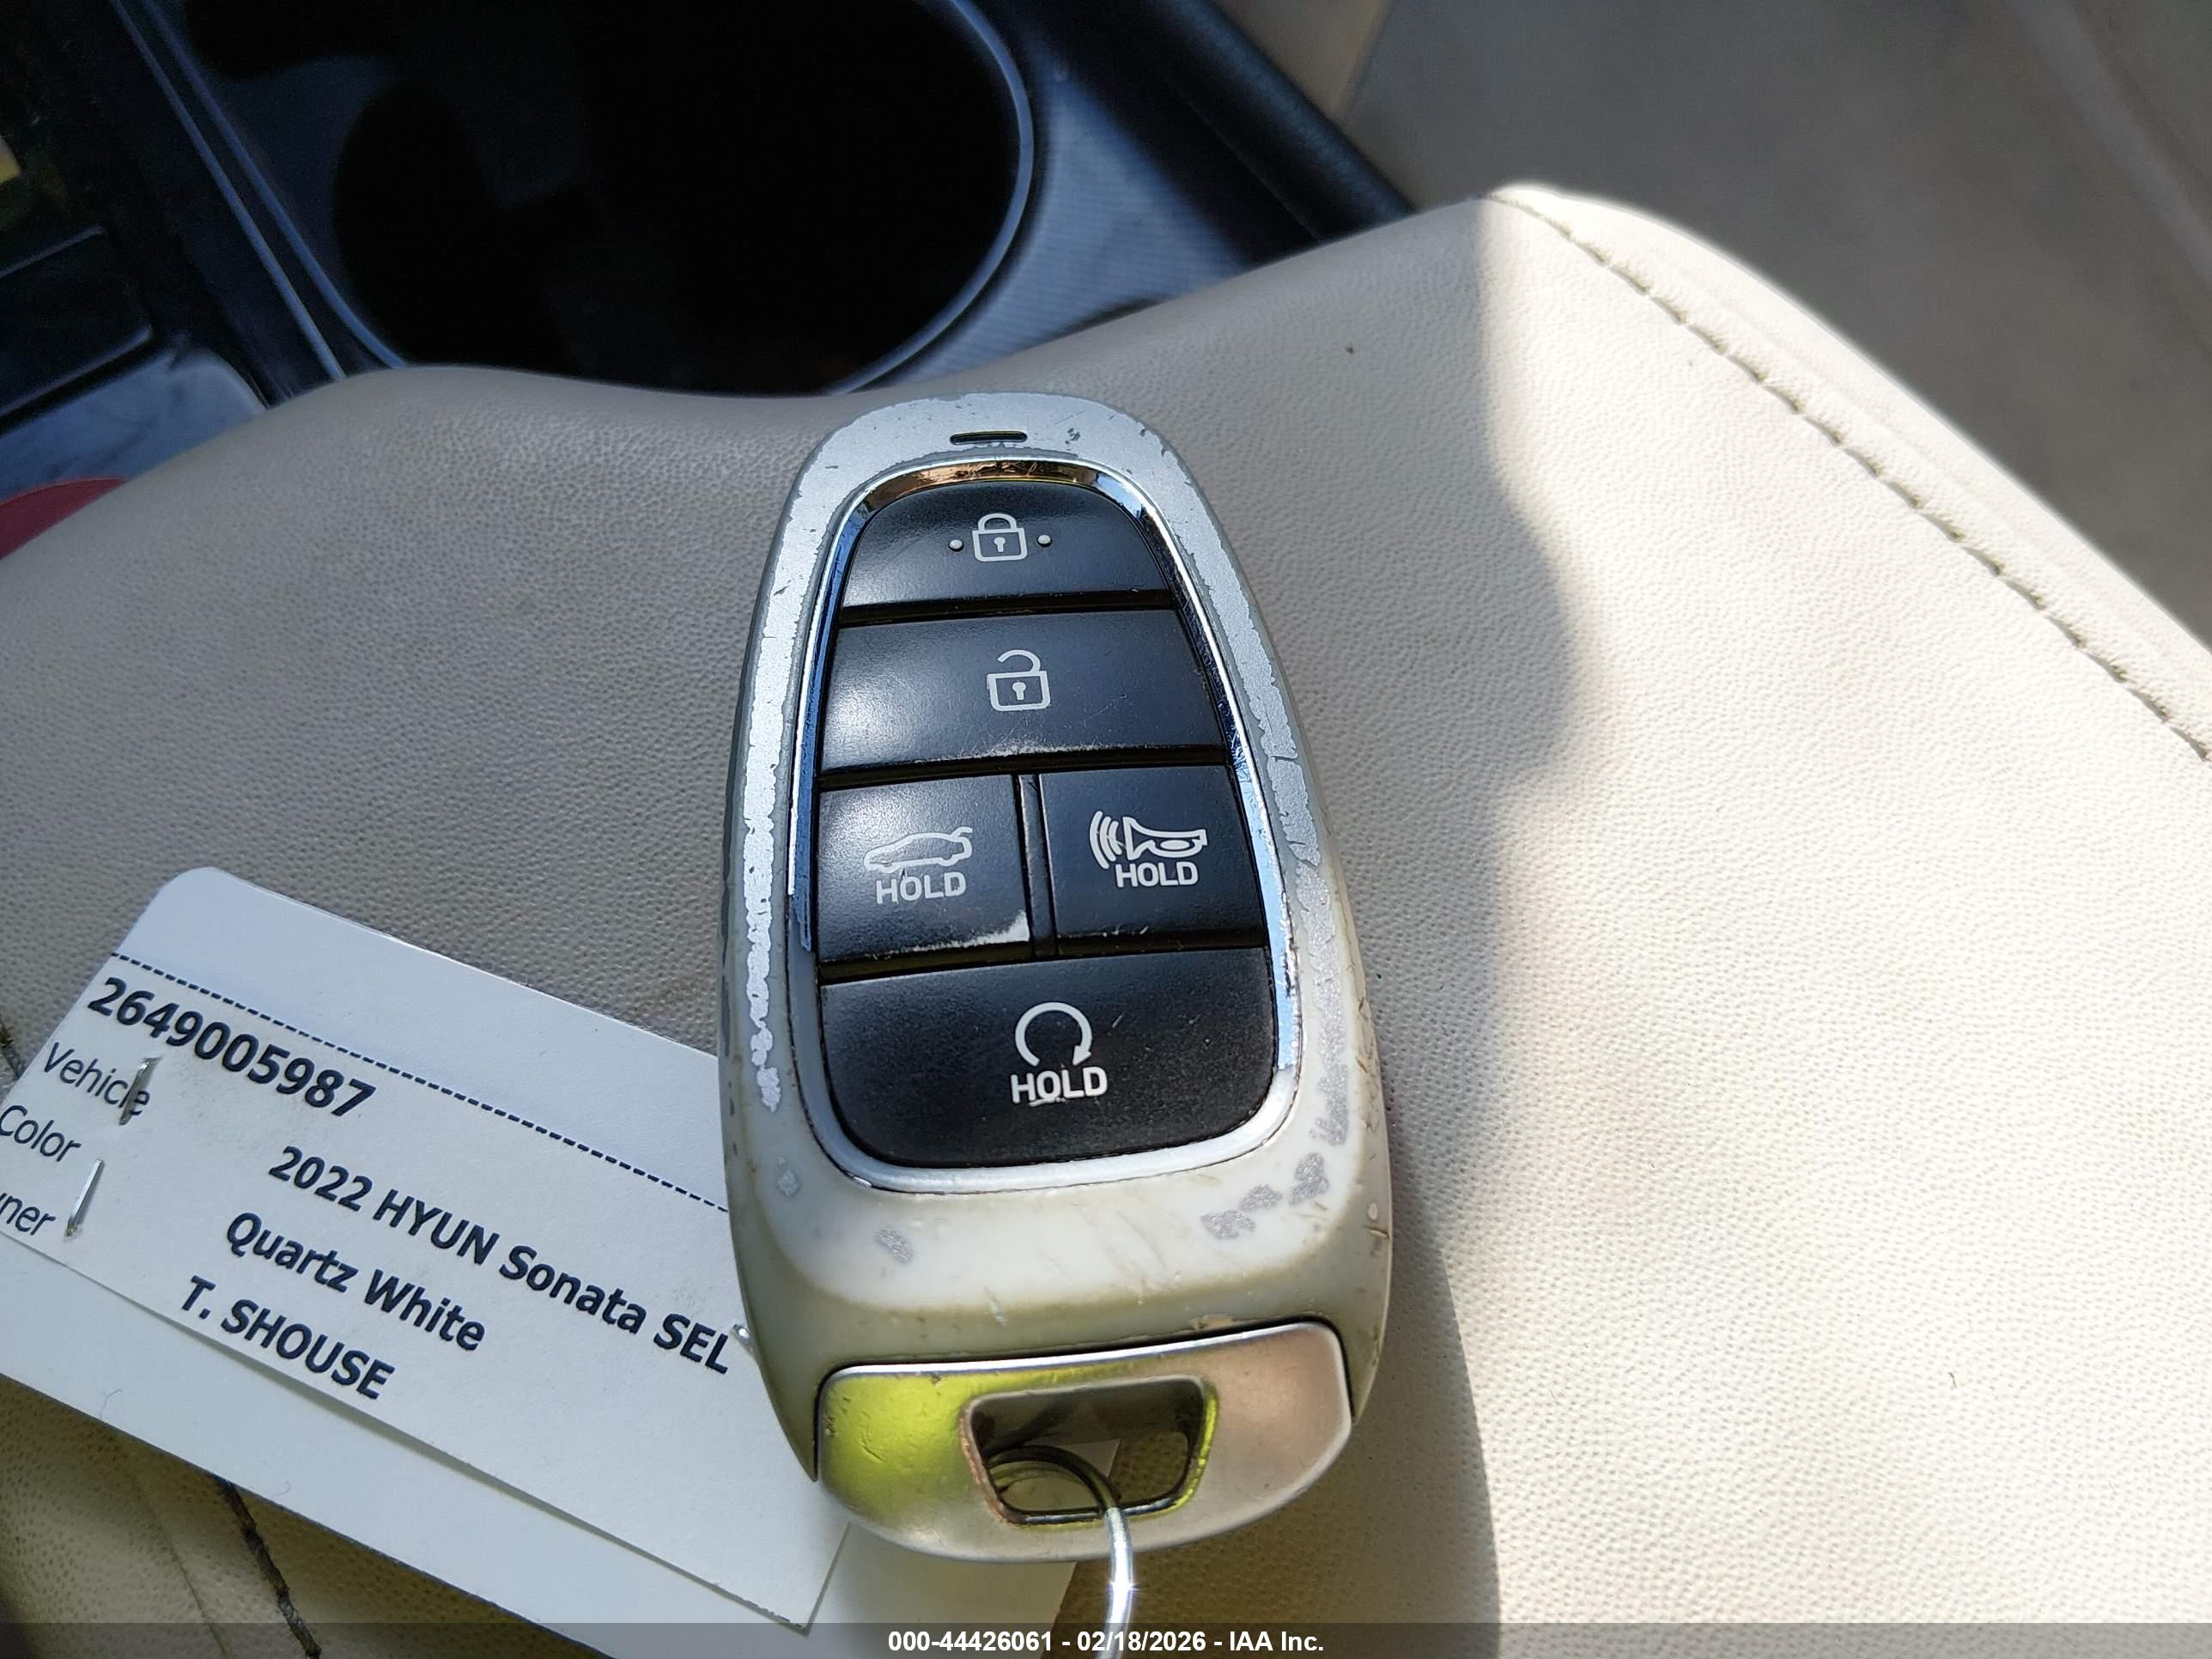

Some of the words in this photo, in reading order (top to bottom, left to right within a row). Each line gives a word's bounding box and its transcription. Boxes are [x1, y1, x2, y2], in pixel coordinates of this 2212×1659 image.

[875, 871, 967, 904] HOLD
[1115, 861, 1199, 888] HOLD
[86, 976, 379, 1119] 2649005987
[1010, 1066, 1108, 1103] HOLD
[0, 1104, 82, 1162] Color
[226, 1212, 358, 1293] Quartz
[364, 1269, 486, 1352] White
[0, 1192, 56, 1236] ner
[181, 1275, 216, 1321] T.
[221, 1298, 395, 1401] SHOUSE
[268, 1146, 373, 1212] 2022
[373, 1188, 499, 1266] HYUN
[500, 1246, 648, 1334] Sonata
[654, 1316, 729, 1375] SEL
